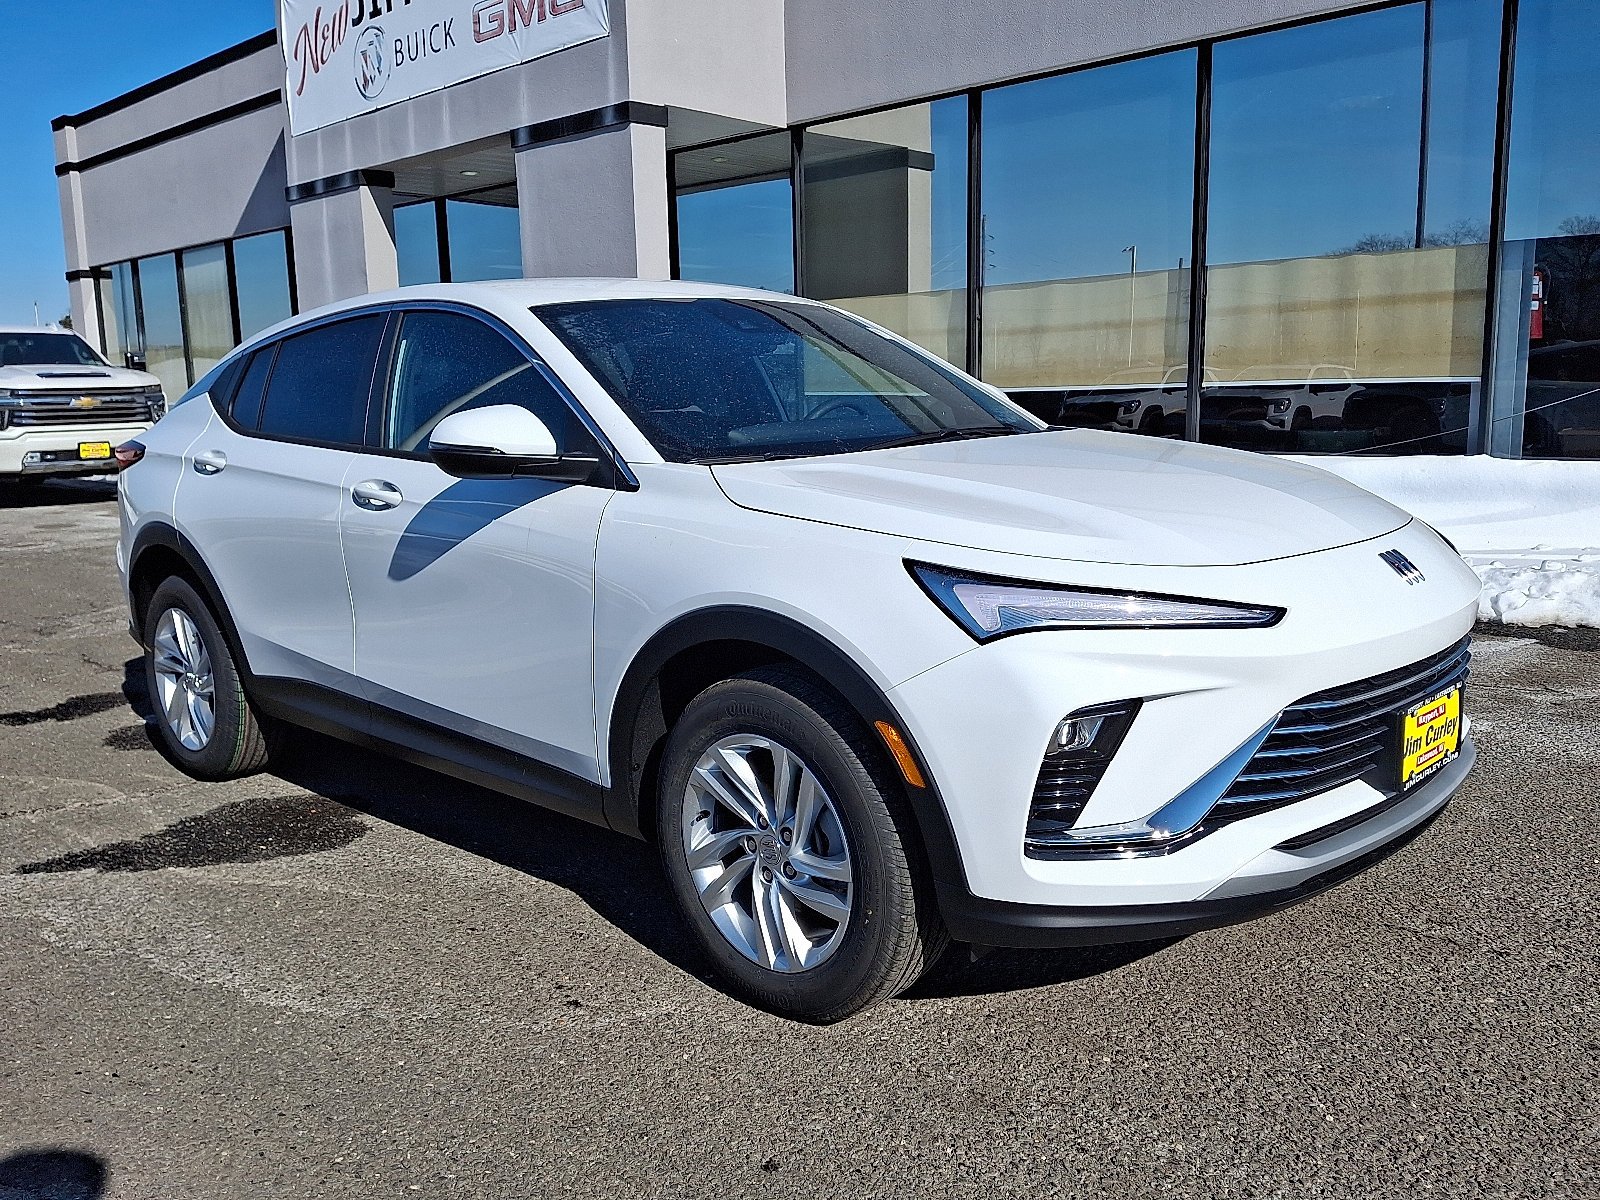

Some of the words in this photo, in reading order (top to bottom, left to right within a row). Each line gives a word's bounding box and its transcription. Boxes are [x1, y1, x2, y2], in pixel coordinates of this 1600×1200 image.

[294, 0, 349, 97] New
[394, 17, 456, 67] BUICK
[1403, 736, 1422, 758] Jim
[1426, 715, 1459, 747] Curley
